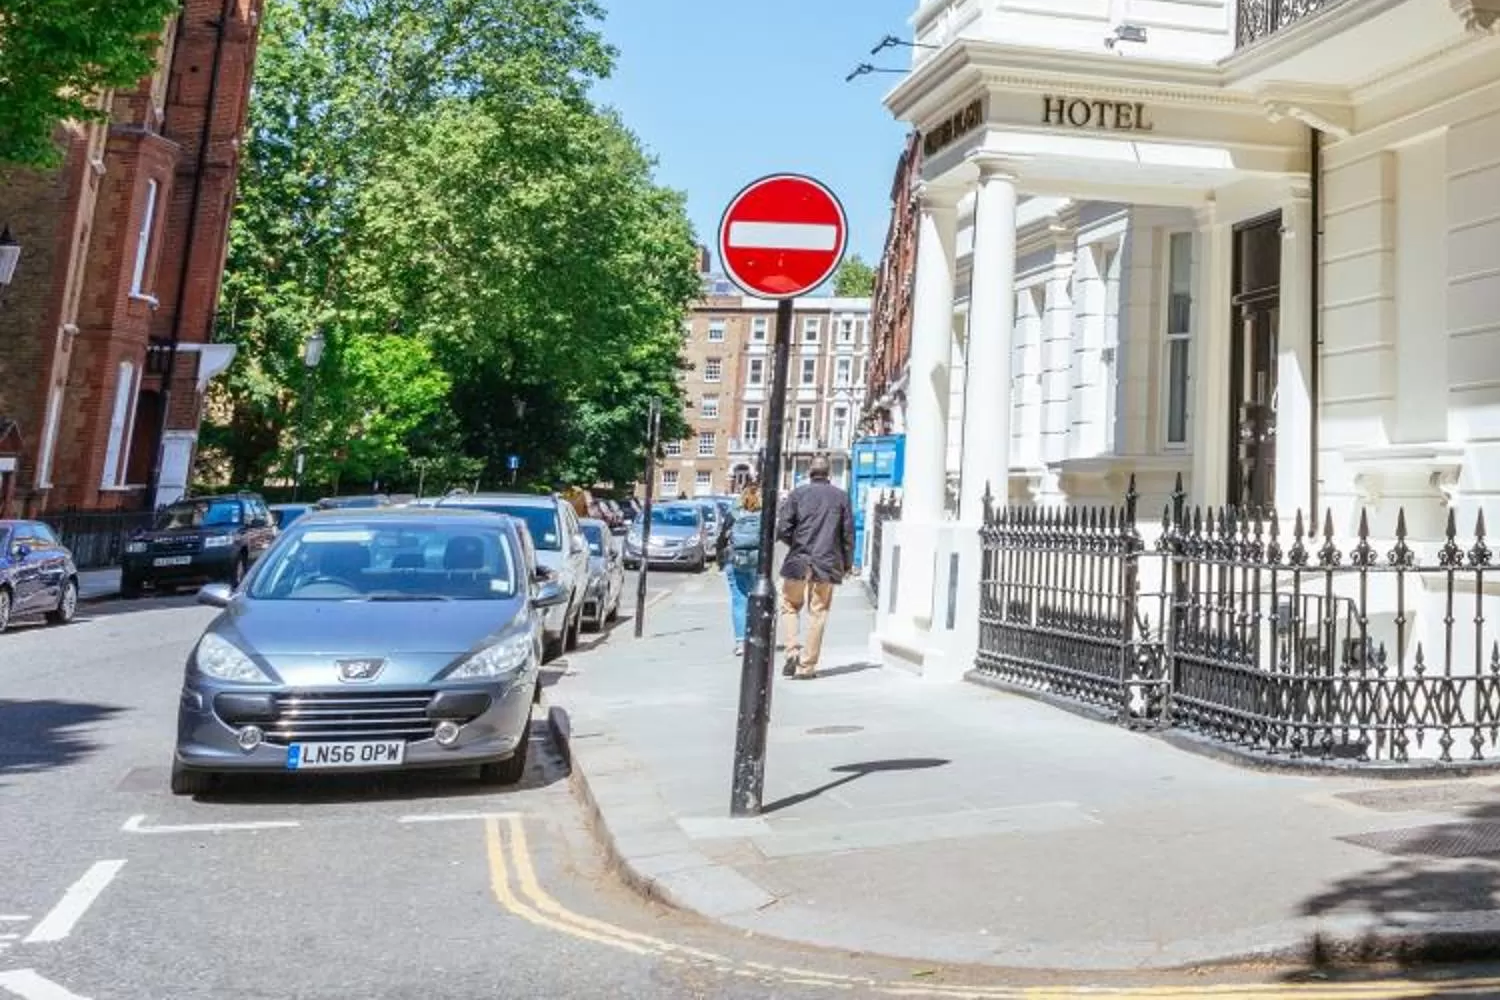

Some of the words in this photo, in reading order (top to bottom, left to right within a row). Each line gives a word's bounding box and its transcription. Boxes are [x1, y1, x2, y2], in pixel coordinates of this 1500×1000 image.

[1041, 95, 1153, 130] HOTEL
[302, 744, 356, 764] LN56
[361, 743, 400, 762] OPW
